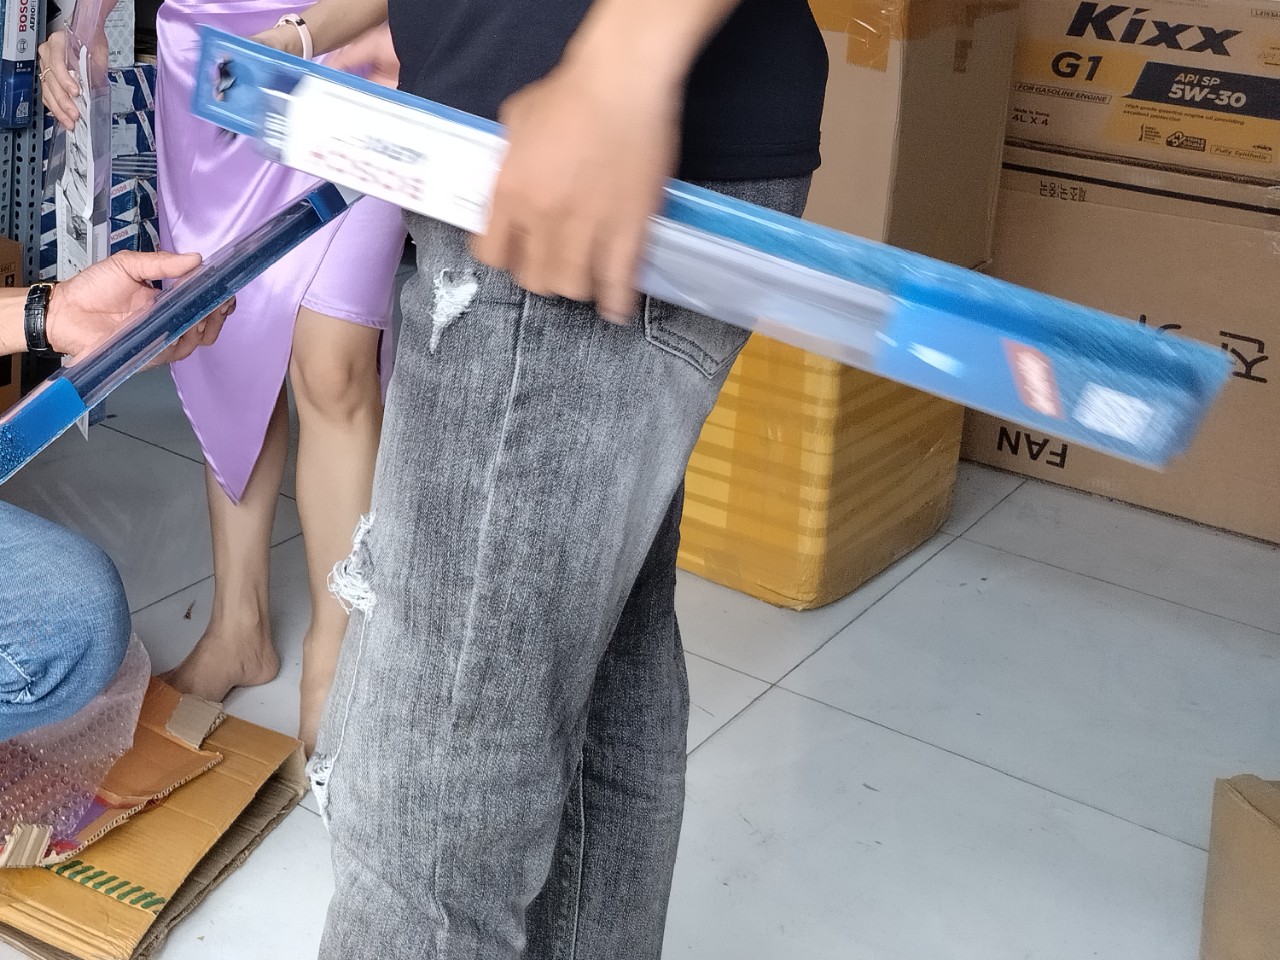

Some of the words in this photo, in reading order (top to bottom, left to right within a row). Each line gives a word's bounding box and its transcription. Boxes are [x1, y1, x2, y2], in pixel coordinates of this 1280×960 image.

[1065, 1, 1243, 57] Kixx
[1051, 51, 1103, 82] G1
[1174, 73, 1200, 86] API
[1201, 75, 1220, 86] SP
[1017, 84, 1035, 93] FOR
[1034, 86, 1075, 98] GASOLINE
[1075, 91, 1108, 103] ENGINE
[1168, 83, 1247, 108] 5W-30
[1012, 114, 1027, 124] 4L
[1029, 116, 1038, 125] X
[1040, 118, 1049, 127] 4
[1123, 110, 1148, 119] excellent
[1149, 113, 1181, 123] protection
[1125, 103, 1138, 112] High
[1139, 105, 1157, 114] grade
[1158, 108, 1182, 117] gasoline
[1183, 111, 1203, 121] engine
[1214, 116, 1245, 127] providing
[1214, 146, 1233, 157] Fully
[1233, 149, 1268, 161] Synthetic
[996, 426, 1068, 469] FAN
